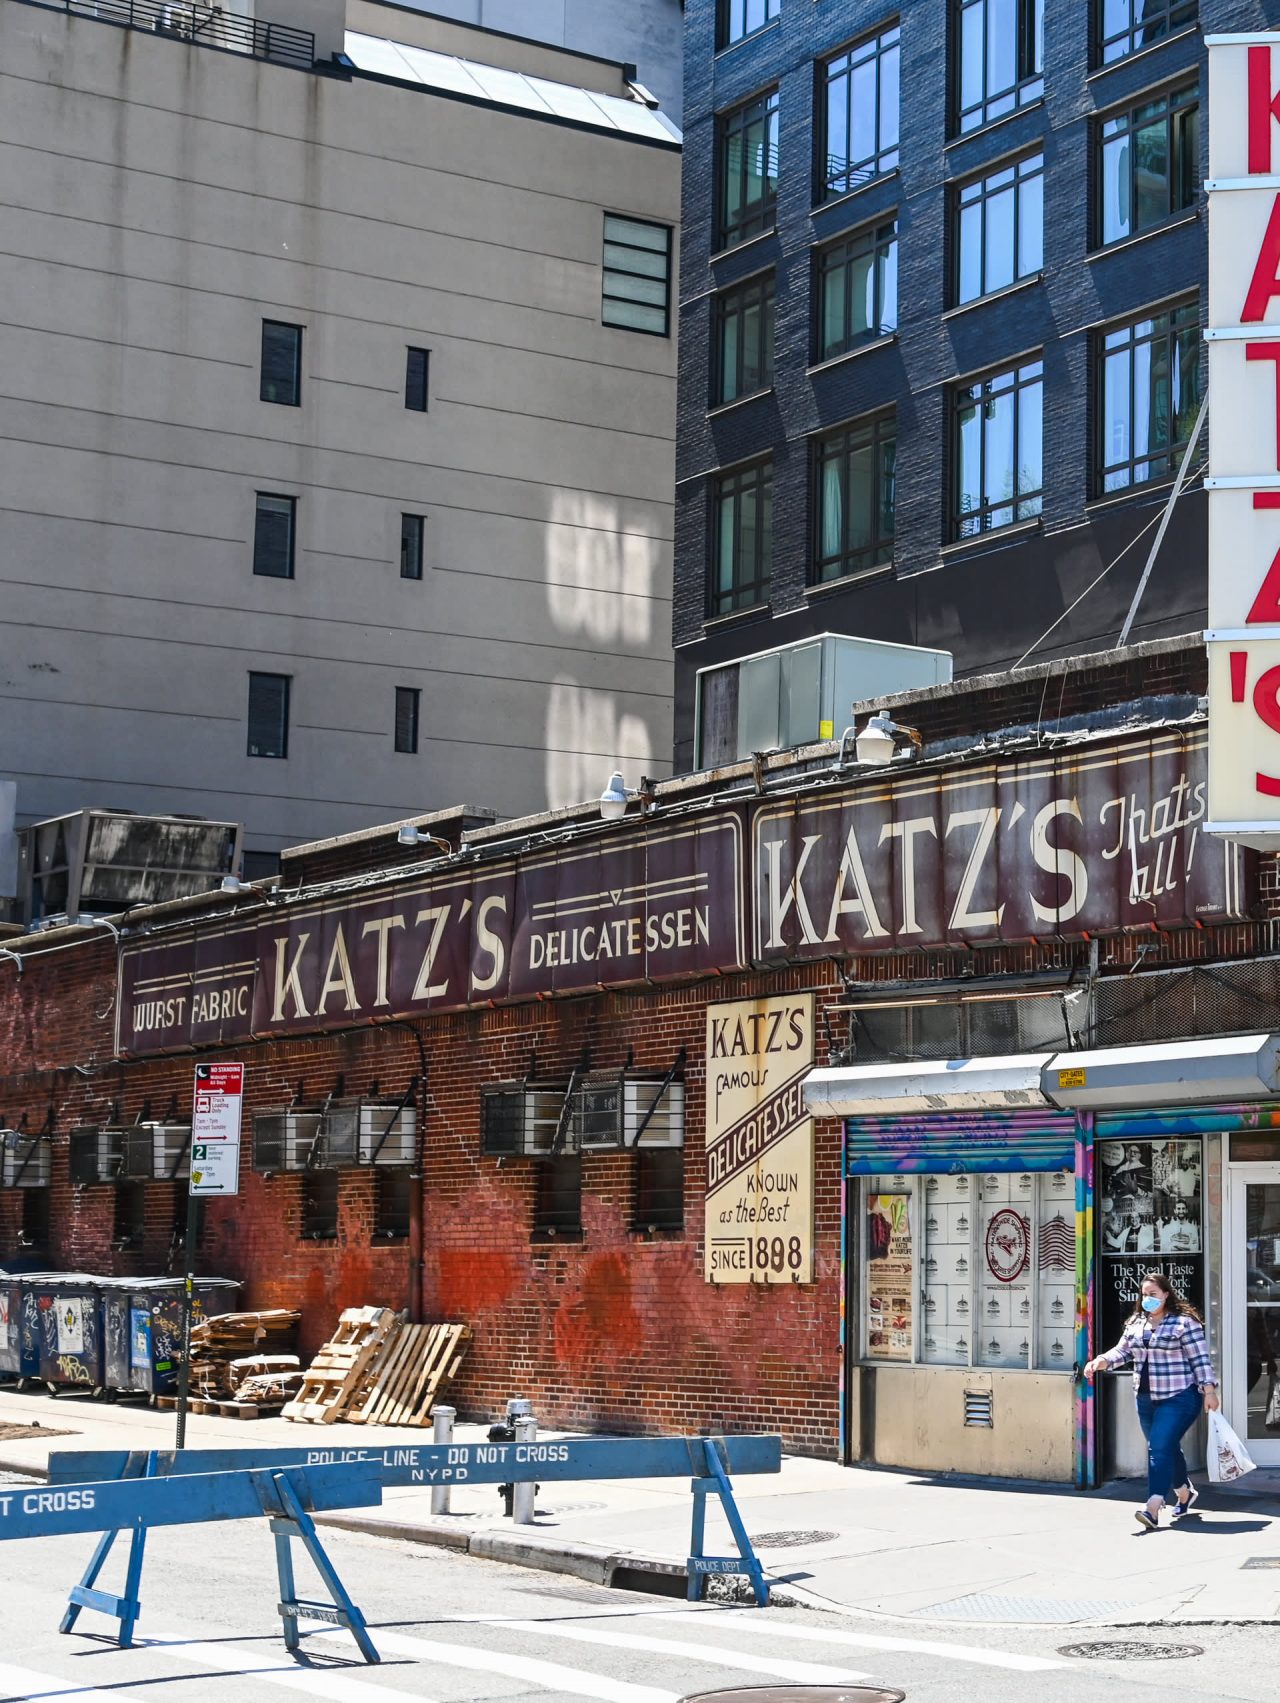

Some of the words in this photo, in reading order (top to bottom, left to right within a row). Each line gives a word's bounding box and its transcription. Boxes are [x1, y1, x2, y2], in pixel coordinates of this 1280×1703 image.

[763, 796, 1088, 949] KATZ'S
[529, 905, 710, 970] DELICATESSEN
[270, 894, 508, 1023] KATZ'S
[133, 997, 186, 1033] WURST
[191, 985, 248, 1025] FABRIC
[710, 1005, 805, 1059] KATZ'S
[716, 1069, 768, 1125] FAMOUS
[196, 1146, 204, 1160] 2
[747, 1170, 798, 1193] KNOWN
[720, 1210, 733, 1223] as
[736, 1198, 756, 1223] the
[757, 1196, 790, 1223] Best
[711, 1250, 746, 1269] SINCE
[1110, 1263, 1134, 1277] The
[1136, 1263, 1164, 1276] Real
[1166, 1262, 1195, 1275] Taste
[1114, 1276, 1128, 1289] of
[1119, 1290, 1139, 1302] Sin
[383, 1449, 420, 1467] LINE
[448, 1447, 469, 1465] DO
[476, 1446, 509, 1464] NOT
[515, 1445, 569, 1463] CROSS
[411, 1468, 469, 1481] NYPD
[23, 1490, 95, 1514] CROSS
[695, 1561, 719, 1571] POLICE
[722, 1561, 740, 1572] DEPT
